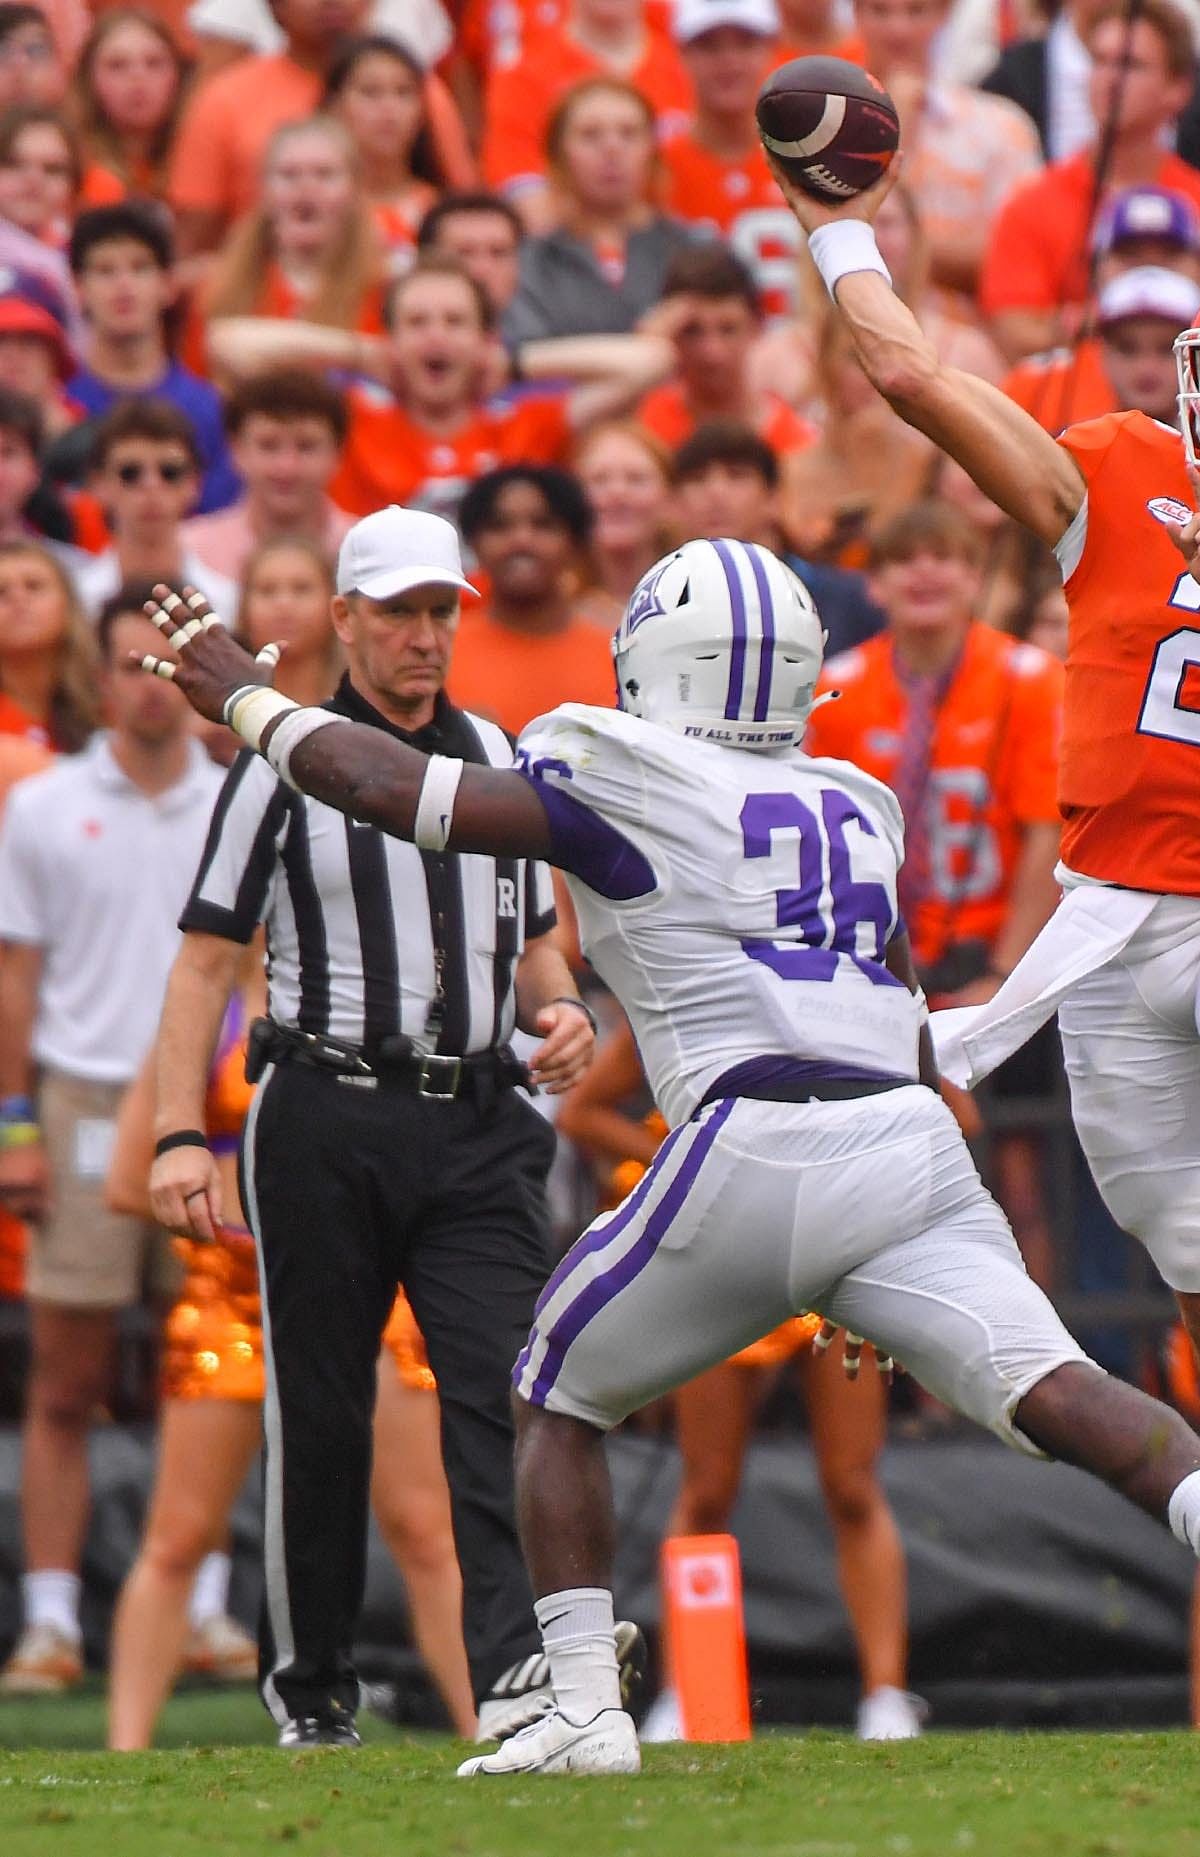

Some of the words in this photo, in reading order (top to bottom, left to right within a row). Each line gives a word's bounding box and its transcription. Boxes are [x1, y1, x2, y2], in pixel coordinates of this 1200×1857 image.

[1155, 502, 1191, 520] ACC
[684, 726, 703, 736] FU
[706, 729, 732, 741] ALL
[737, 732, 764, 742] THE
[767, 731, 794, 743] TIME
[496, 877, 517, 918] R
[738, 789, 906, 988] 36
